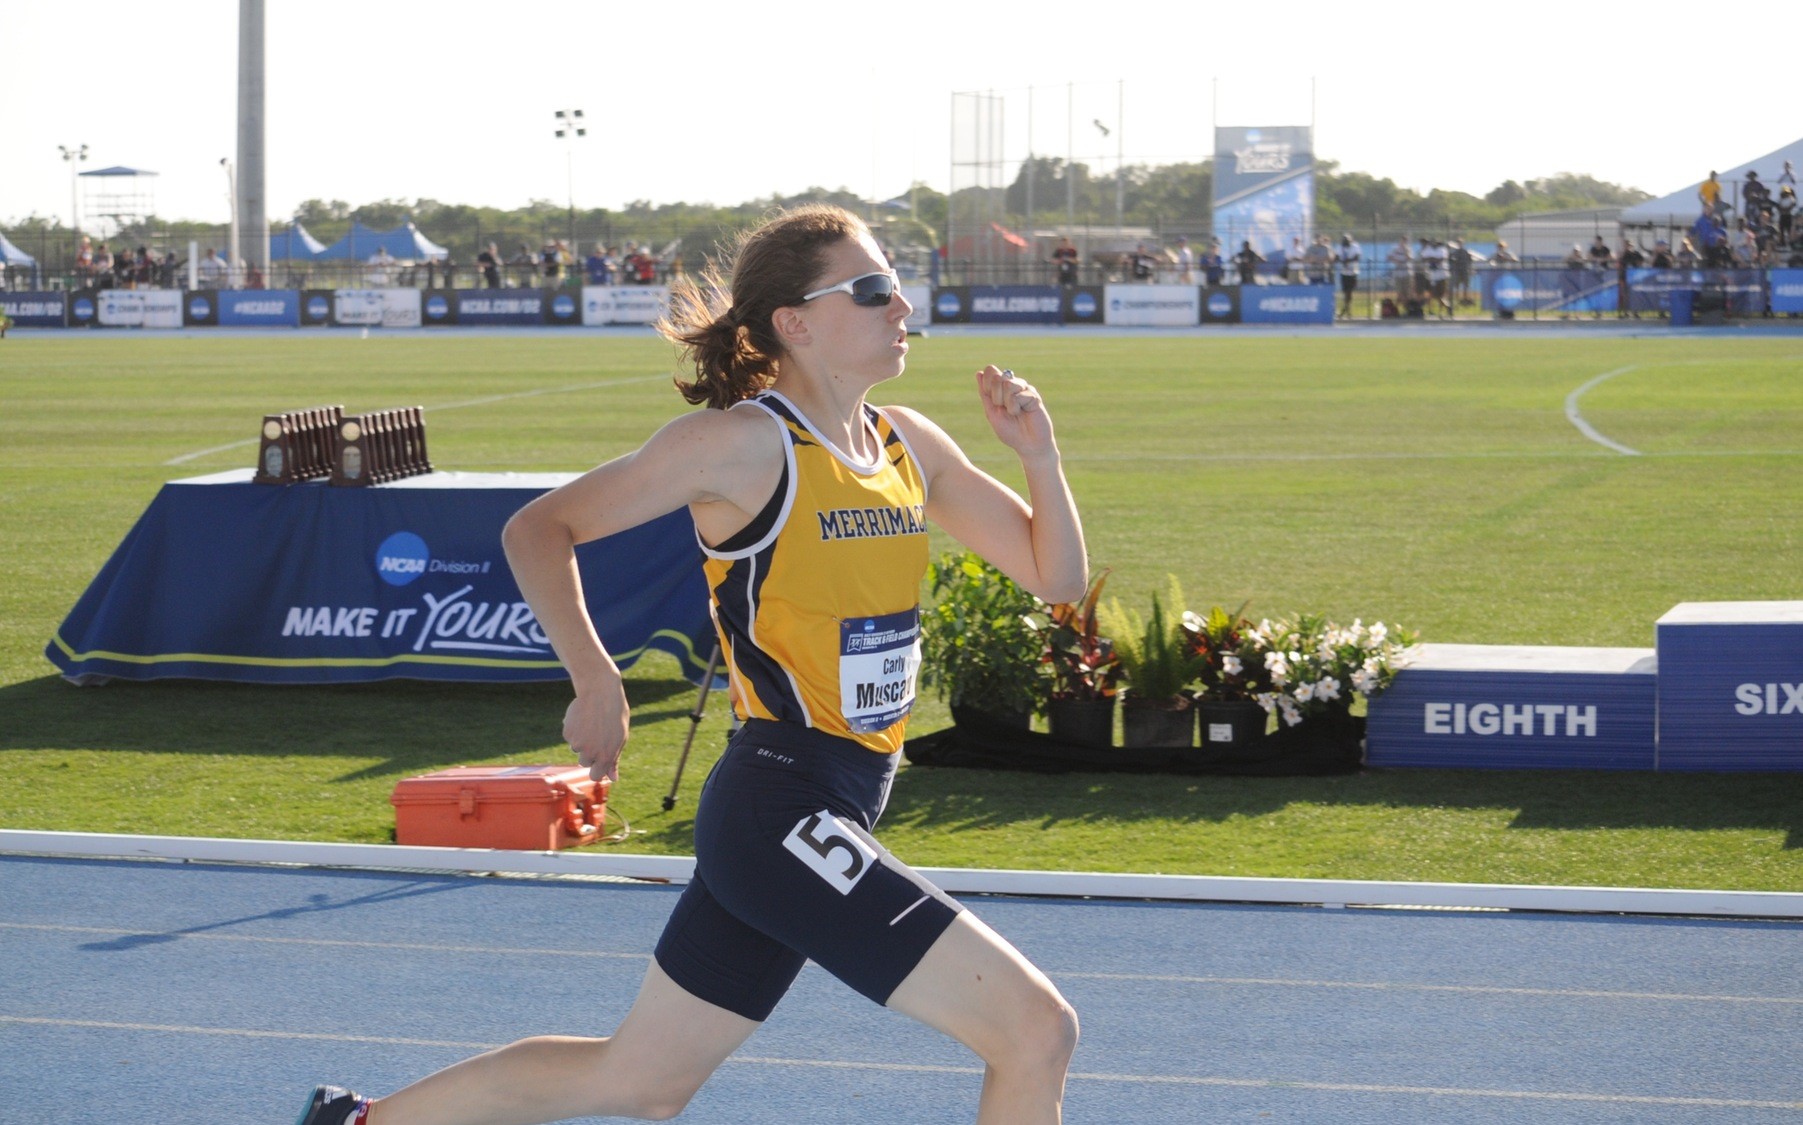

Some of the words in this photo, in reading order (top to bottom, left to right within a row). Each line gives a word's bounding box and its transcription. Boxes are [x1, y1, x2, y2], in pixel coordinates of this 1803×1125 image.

[816, 504, 928, 541] MERRIMAC
[380, 556, 428, 574] NCAA
[429, 559, 480, 574] Division
[281, 606, 379, 637] MAKE
[381, 607, 418, 638] IT
[863, 636, 882, 646] TRACK
[883, 655, 906, 675] Carly
[1424, 701, 1597, 737] EIGHTH
[757, 748, 794, 764] DRI-FIT
[796, 813, 864, 881] 5
